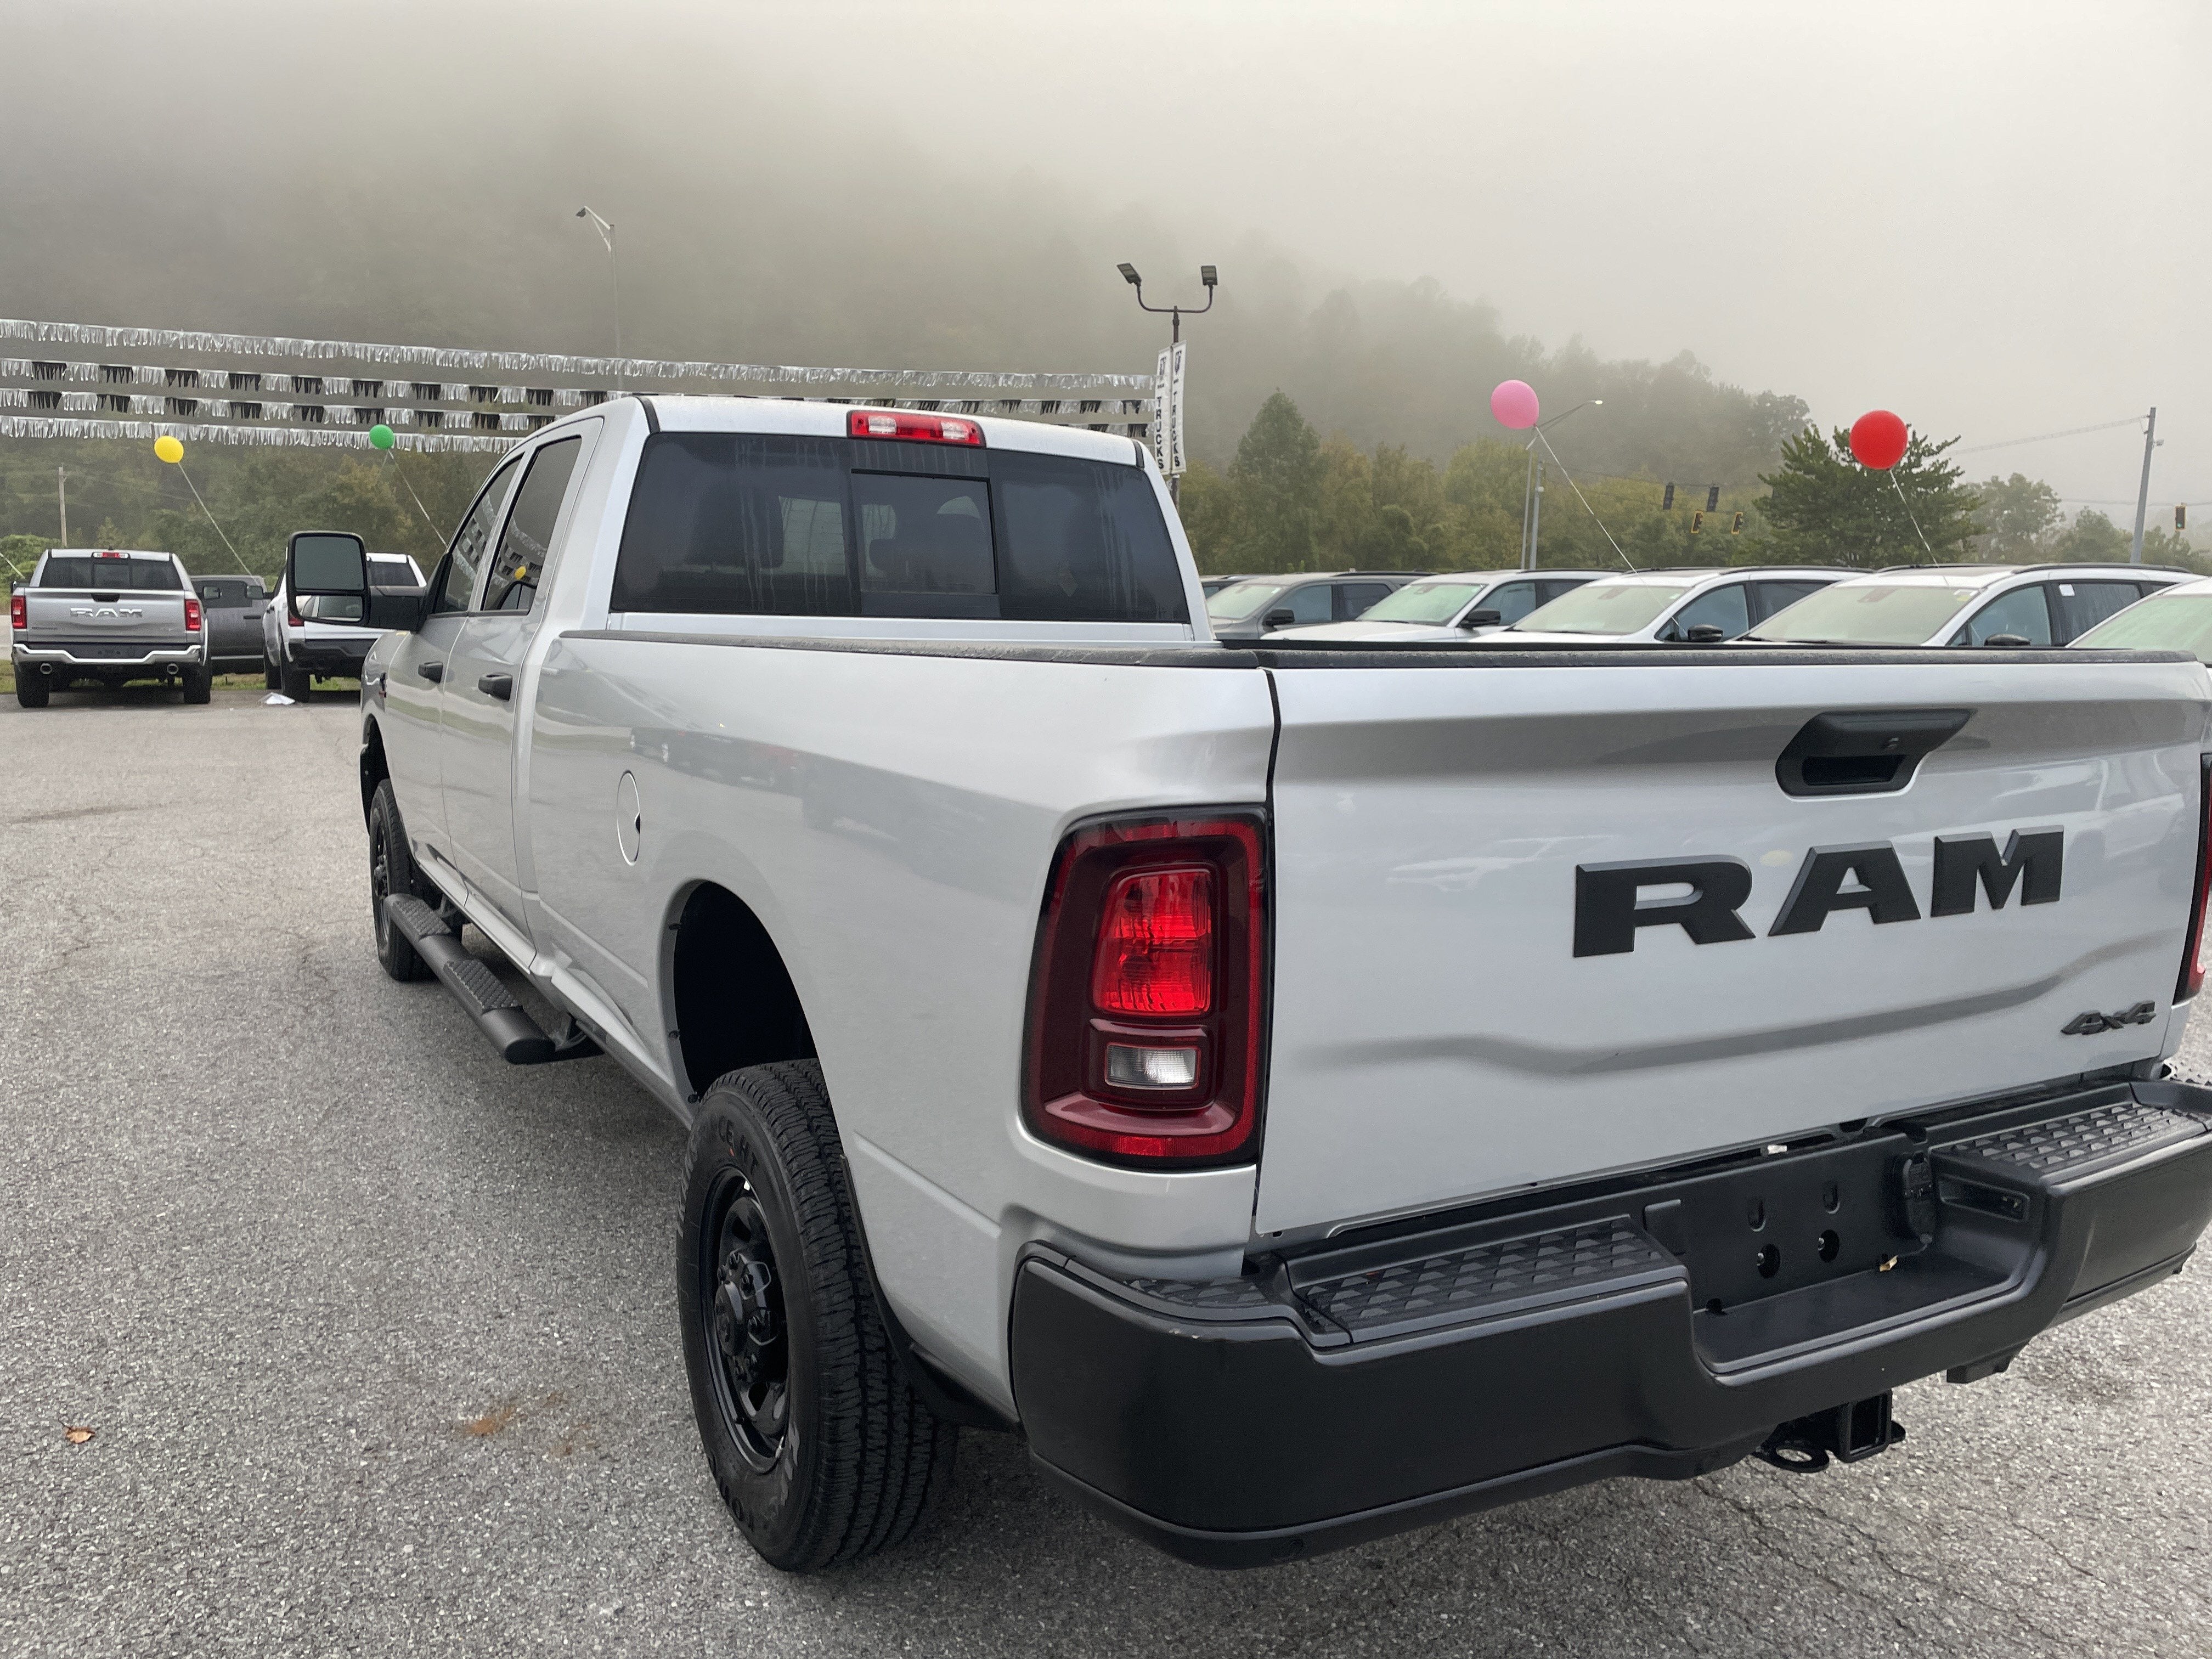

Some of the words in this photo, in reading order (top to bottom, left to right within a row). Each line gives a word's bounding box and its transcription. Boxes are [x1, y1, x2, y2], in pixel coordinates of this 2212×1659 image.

[1155, 396, 1164, 470] TRUCKS
[1171, 391, 1181, 467] TRUCKS
[70, 607, 143, 618] RAM
[1573, 824, 2065, 958] RAM
[2060, 1000, 2157, 1036] 4x4
